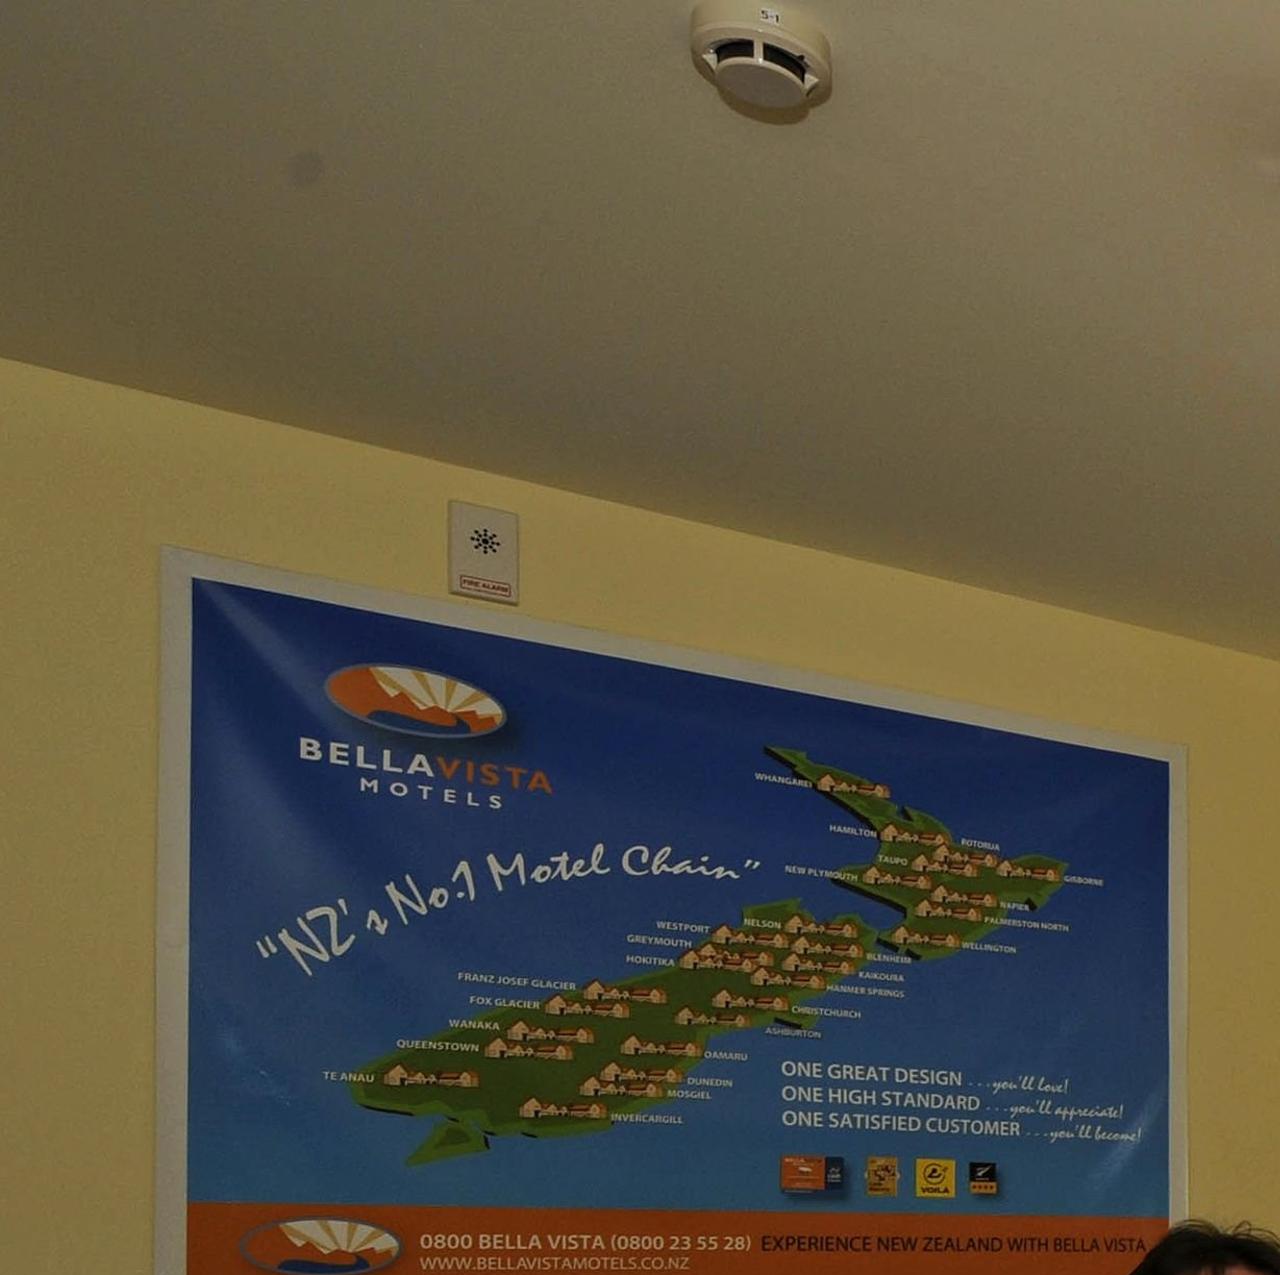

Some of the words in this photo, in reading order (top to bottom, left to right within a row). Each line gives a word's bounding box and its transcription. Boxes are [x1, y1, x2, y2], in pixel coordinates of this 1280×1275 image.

[299, 736, 554, 796] BELLAVISTA
[359, 776, 503, 810] MOTELS
[829, 824, 878, 839] HAMILTON
[385, 860, 476, 927] No.1
[486, 842, 611, 892] Motel
[656, 920, 711, 935] WESTPORT
[744, 917, 782, 930] NELSON
[626, 933, 693, 949] GREYMOUTH
[961, 941, 1017, 955] WELLINGTON
[626, 954, 676, 968] HOKITIKA
[858, 970, 905, 983] KAIKOURA
[791, 1005, 862, 1021] CHRISTCHURCH
[448, 1018, 501, 1032] WANAKA
[765, 1026, 822, 1041] ASHBURTON
[396, 1038, 480, 1054] QUEENSTOWN
[704, 1050, 749, 1063] OAMARU
[687, 1076, 734, 1089] DUNEDIN
[781, 1060, 824, 1078] ONE
[827, 1063, 891, 1083] GREAT
[895, 1066, 963, 1087] DESIGN
[1037, 1077, 1071, 1095] love!
[781, 1085, 824, 1104] ONE
[828, 1087, 879, 1107] HIGH
[881, 1090, 981, 1112] STANDARD
[610, 1112, 684, 1126] INVERCARGILL
[781, 1110, 825, 1128] ONE
[828, 1112, 922, 1132] SATISFIED
[926, 1117, 1021, 1138] CUSTOMER
[420, 1233, 473, 1251] 0800
[478, 1234, 541, 1251] BELLA
[546, 1234, 607, 1252] VISTA
[611, 1234, 666, 1253] (0800
[669, 1236, 693, 1252] 23
[696, 1236, 720, 1252] 55
[723, 1235, 752, 1253] 28)
[761, 1235, 873, 1253] EXPERIENCE
[877, 1236, 918, 1252] NEW
[922, 1236, 1003, 1253] ZEALAND
[1007, 1238, 1049, 1252] WITH
[1054, 1237, 1101, 1253] BELLA
[1104, 1236, 1148, 1253] VISTA
[420, 1255, 690, 1271] WWW.BELLAVISTAMOTELS.CO.NZ
